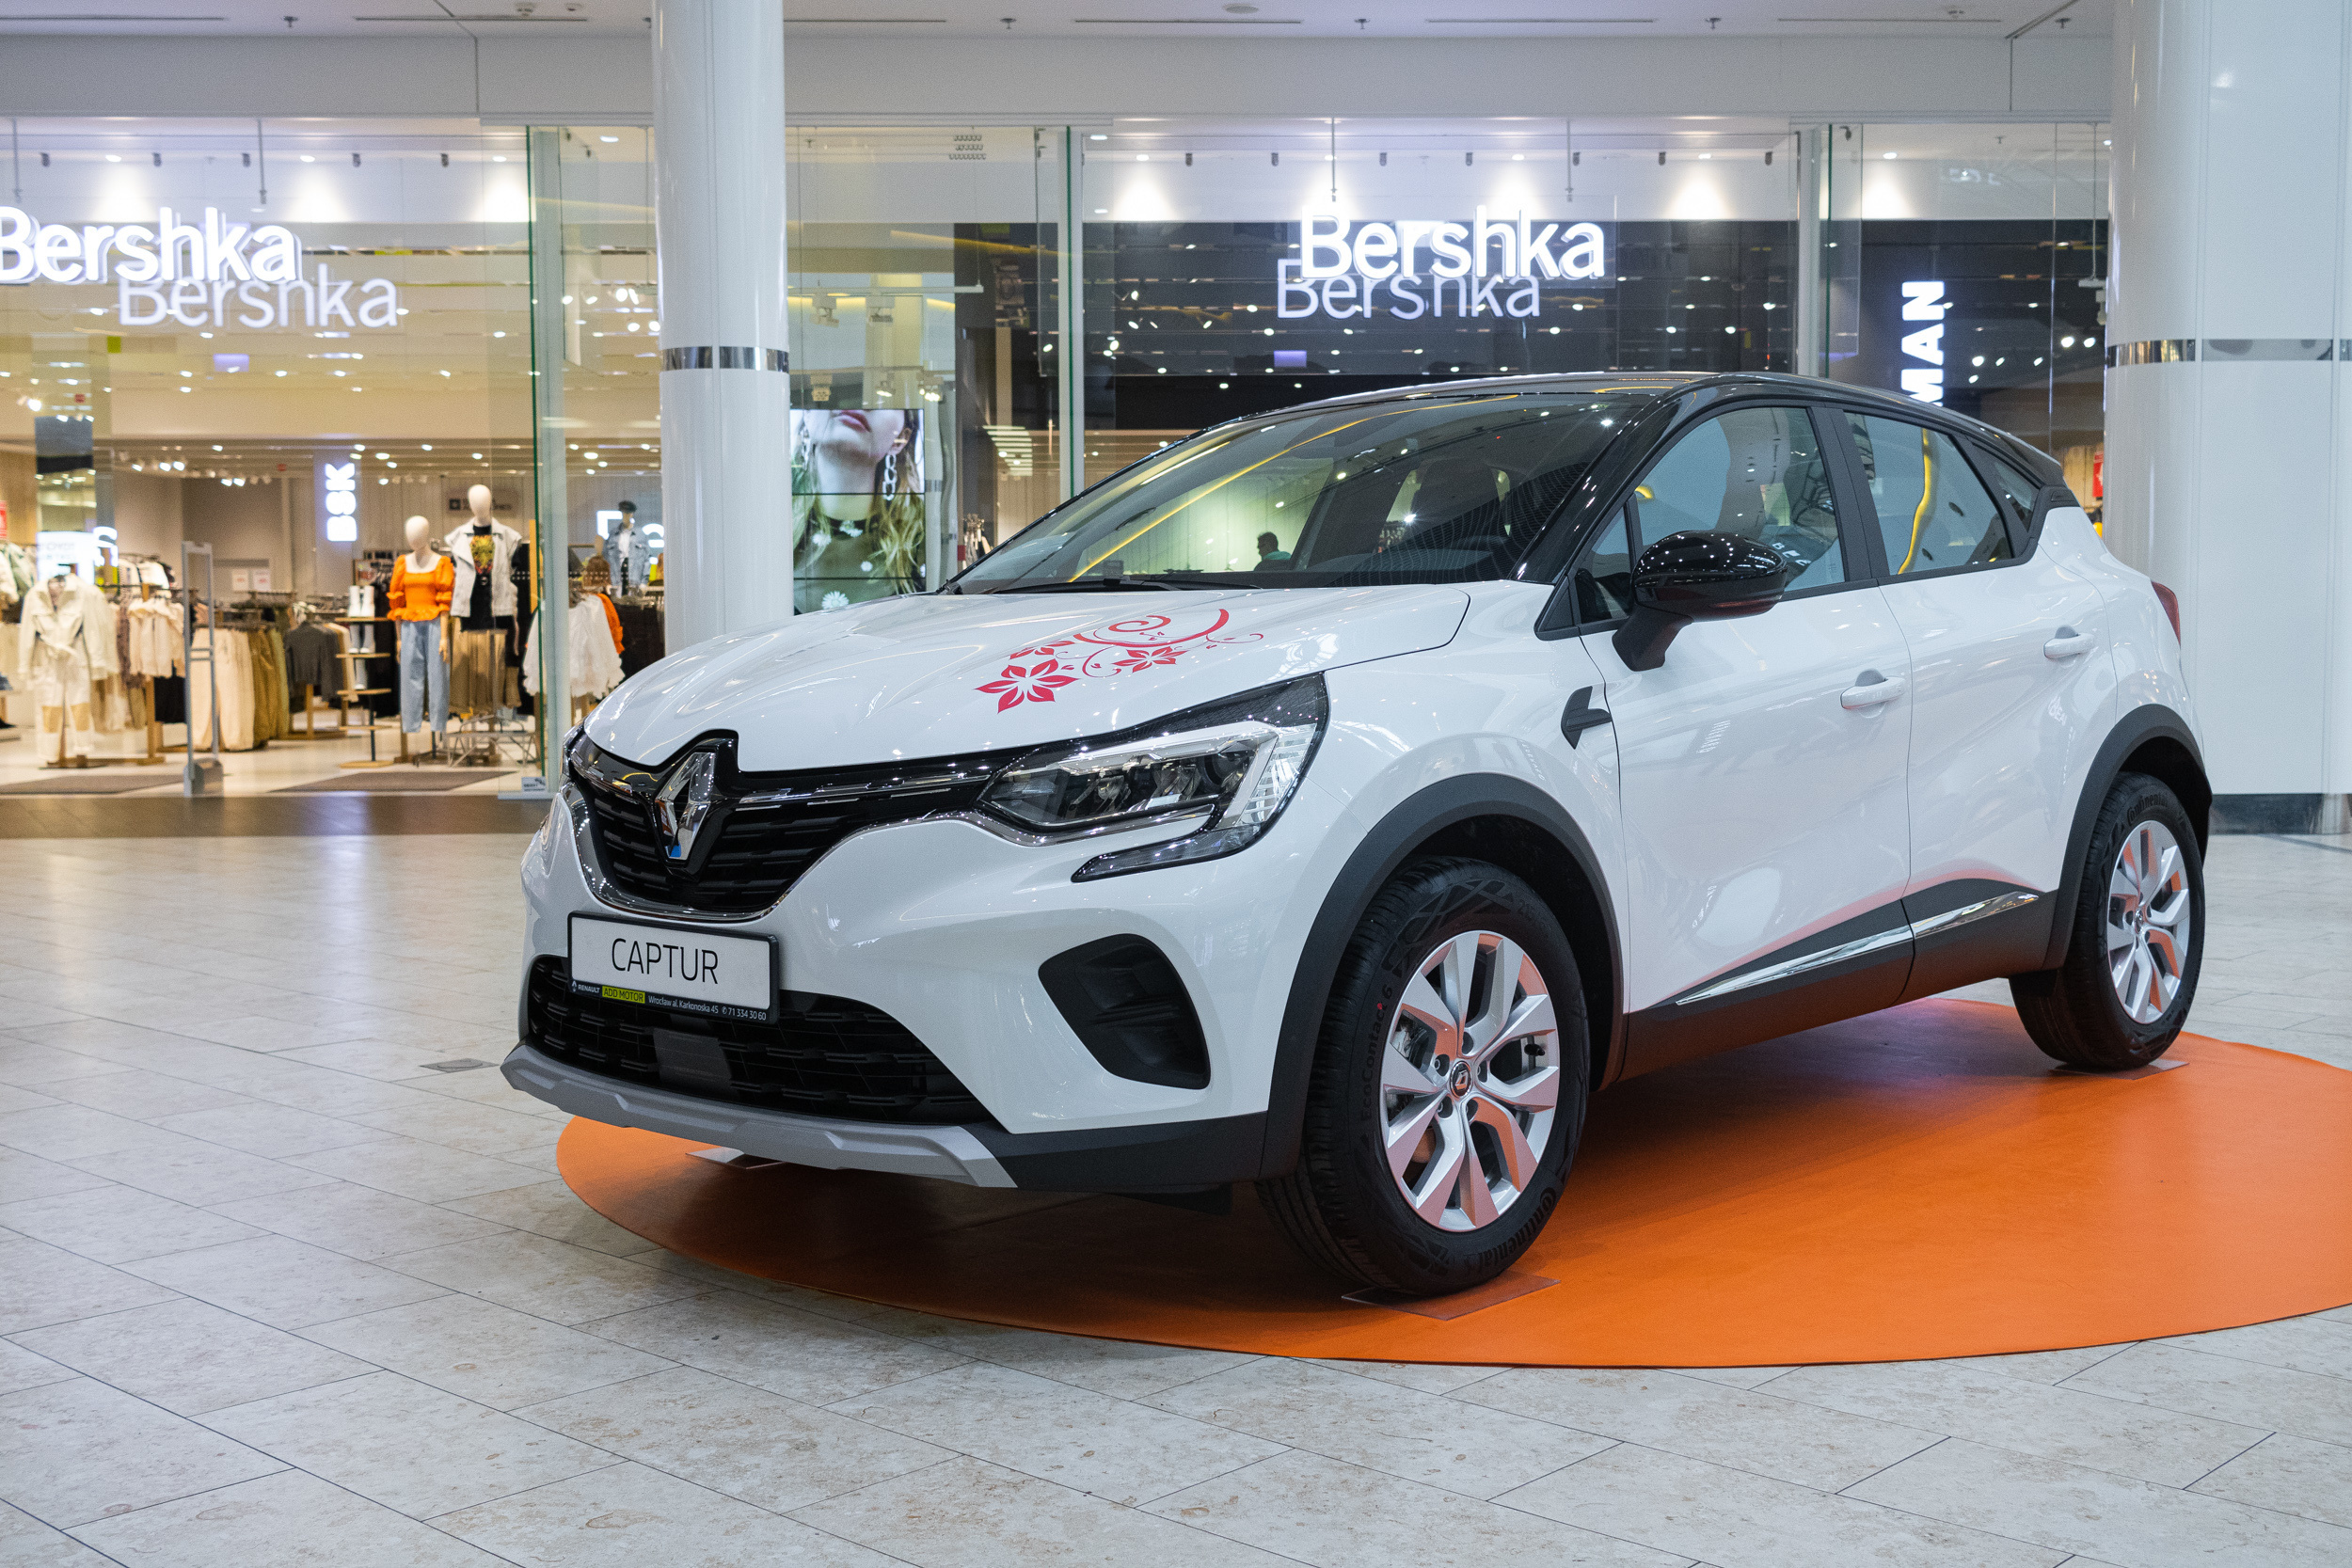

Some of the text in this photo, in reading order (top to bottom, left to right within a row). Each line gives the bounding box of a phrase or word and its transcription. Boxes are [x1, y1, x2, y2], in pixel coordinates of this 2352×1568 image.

[0, 206, 302, 284] Bershka
[1300, 204, 1605, 281] Bershka
[1900, 280, 1945, 407] MAN
[612, 938, 719, 985] CAPTUR
[578, 985, 600, 993] RENAULT
[604, 988, 644, 1002] ADD MOTOR
[648, 995, 672, 1006] Wrocław
[679, 1001, 710, 1013] Karkonoska
[711, 1006, 719, 1014] 45
[728, 1007, 736, 1016] 71
[737, 1009, 749, 1019] 334
[750, 1010, 757, 1020] 30
[758, 1011, 767, 1021] 60
